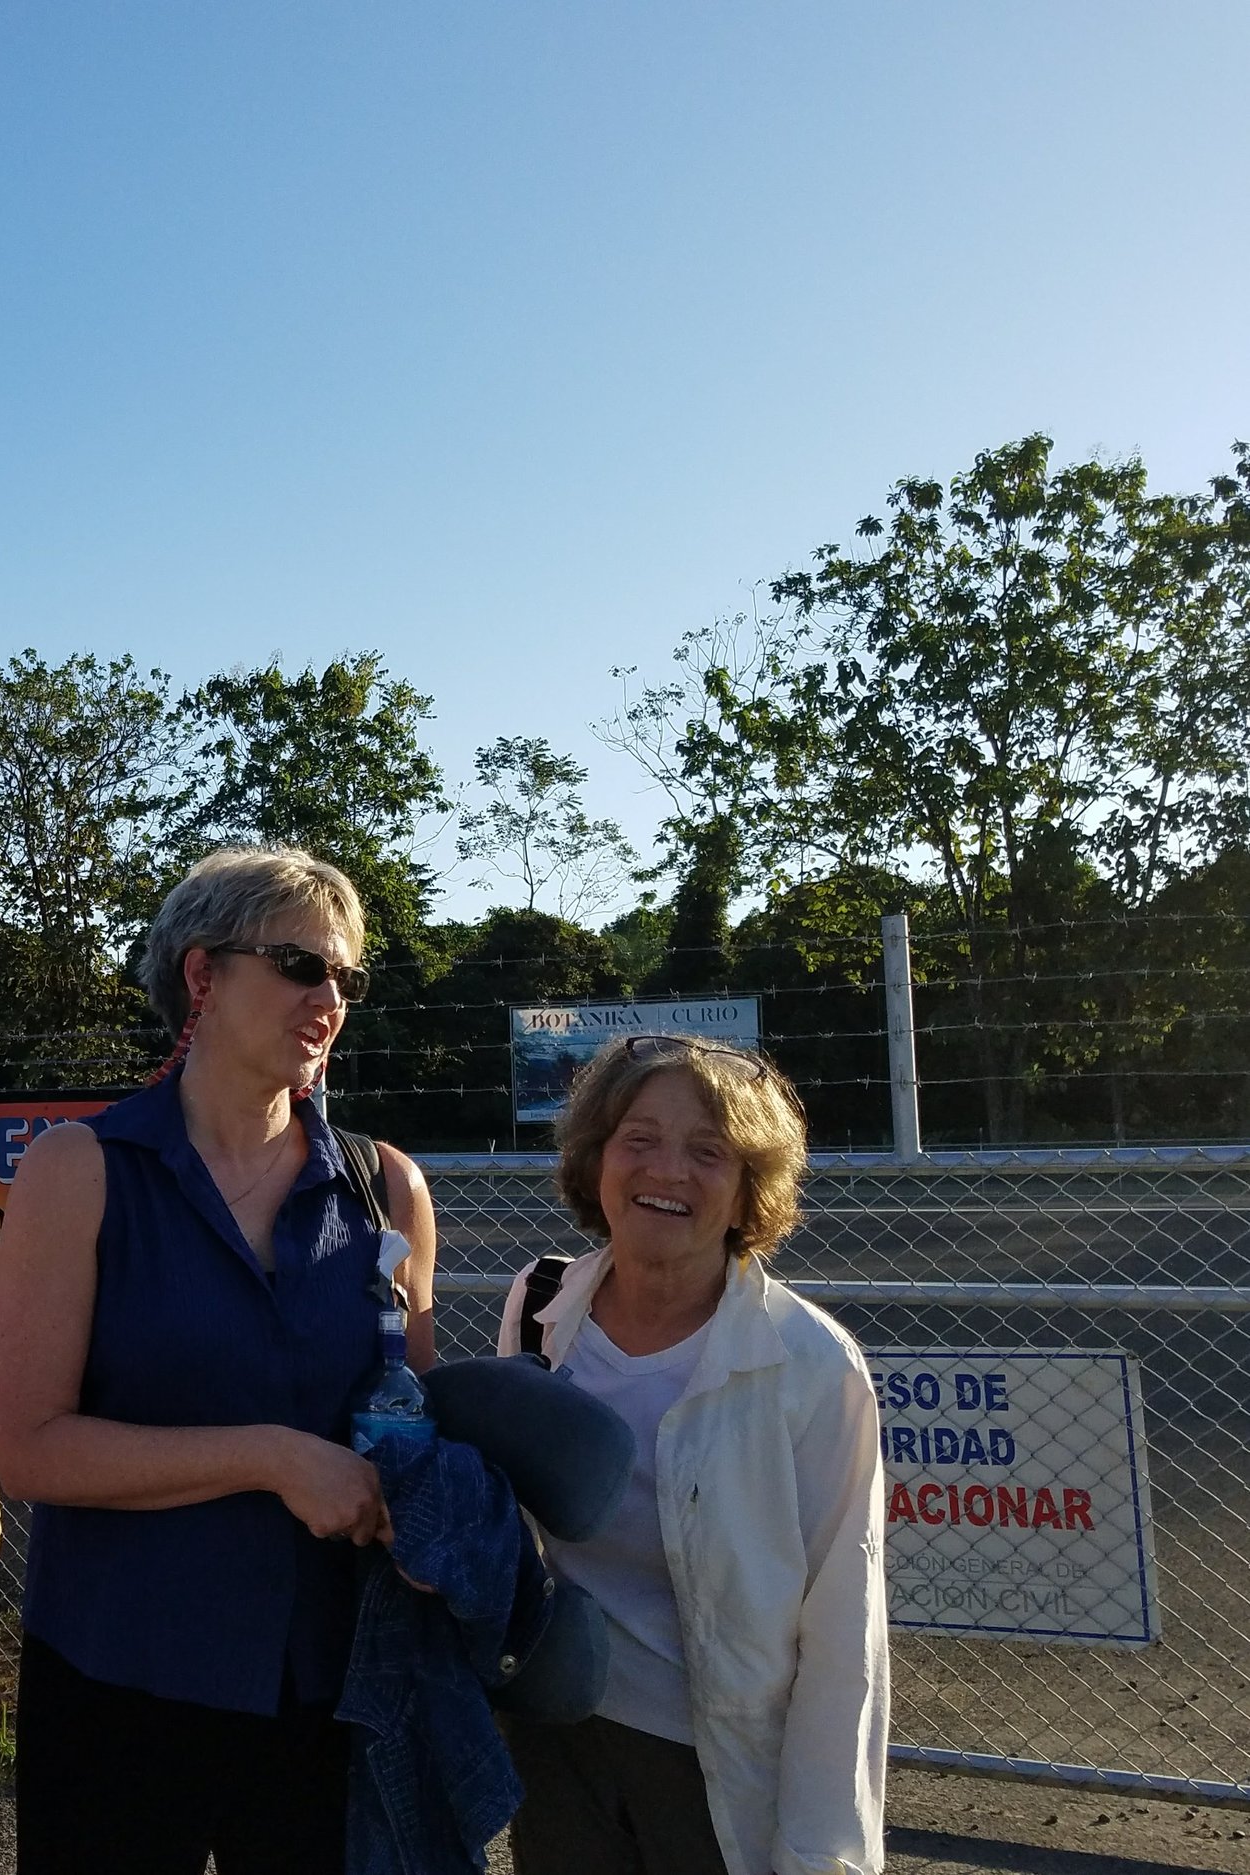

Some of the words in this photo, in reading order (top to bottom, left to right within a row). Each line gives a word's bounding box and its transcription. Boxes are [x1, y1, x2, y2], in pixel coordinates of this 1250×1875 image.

[531, 1010, 643, 1029] BOTANIKA
[671, 1006, 738, 1024] CURIO
[954, 1373, 1009, 1412] DE
[887, 1483, 1095, 1531] ACIONAR
[1056, 1563, 1085, 1579] DE
[999, 1588, 1079, 1615] CIVIL
